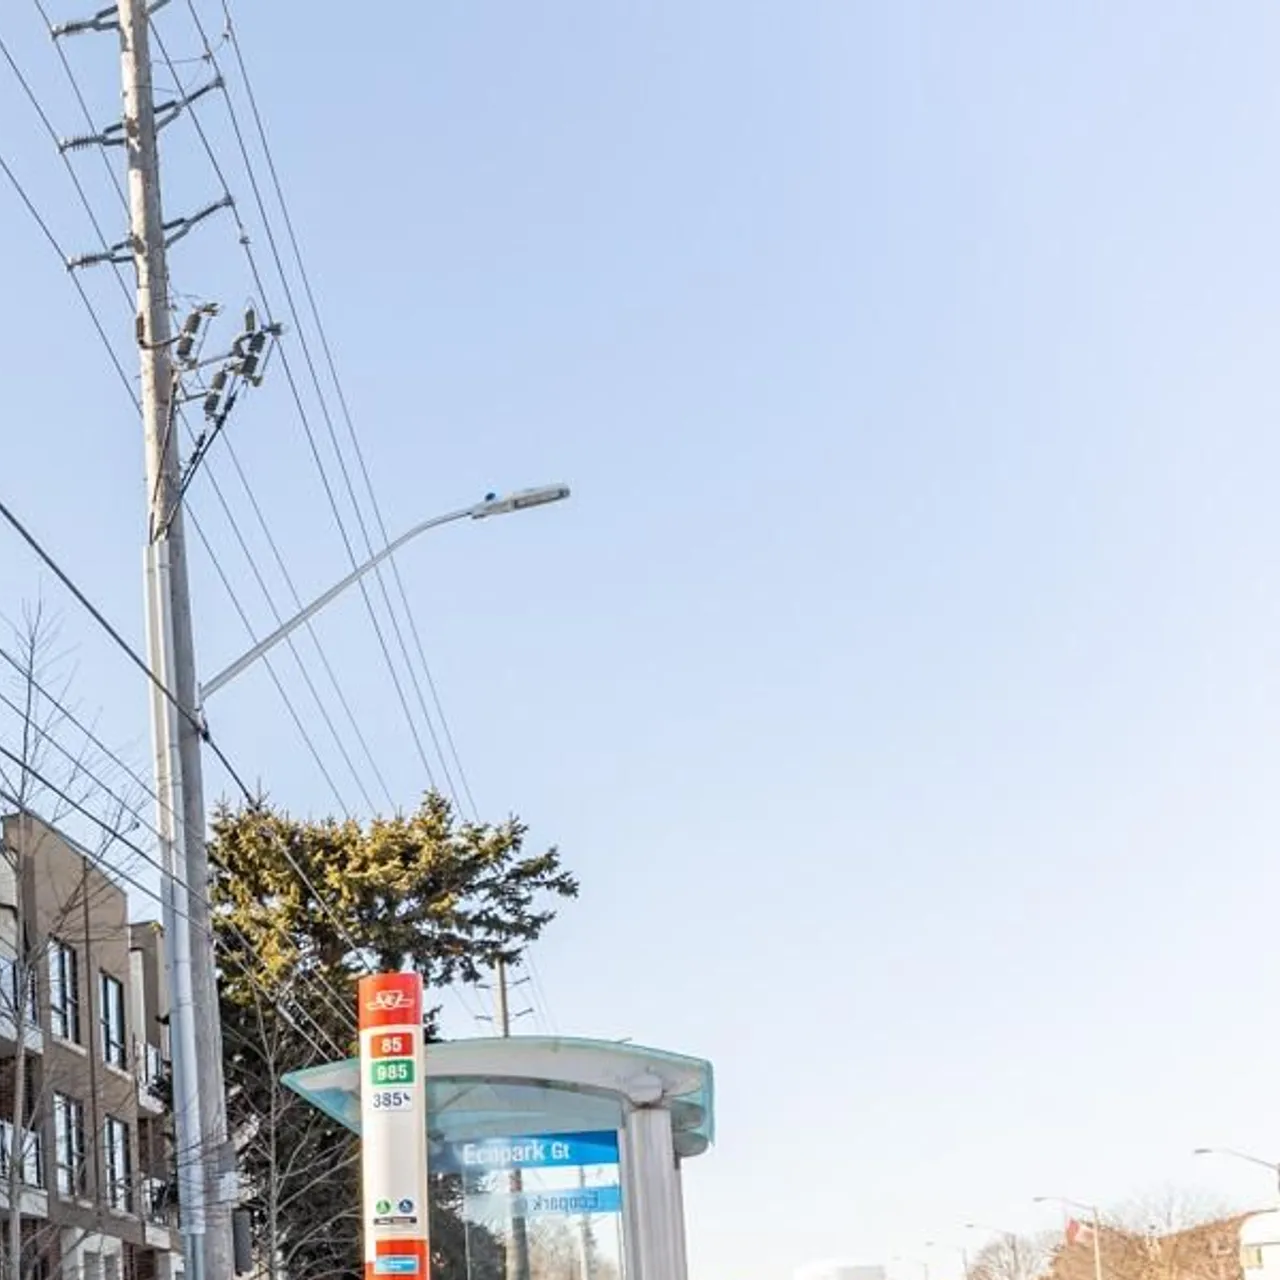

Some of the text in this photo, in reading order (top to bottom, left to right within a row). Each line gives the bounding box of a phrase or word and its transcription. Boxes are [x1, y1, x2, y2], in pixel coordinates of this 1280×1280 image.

[382, 1037, 402, 1053] 85
[376, 1064, 407, 1080] 985
[373, 1092, 402, 1108] 385
[551, 1142, 570, 1160] Gt
